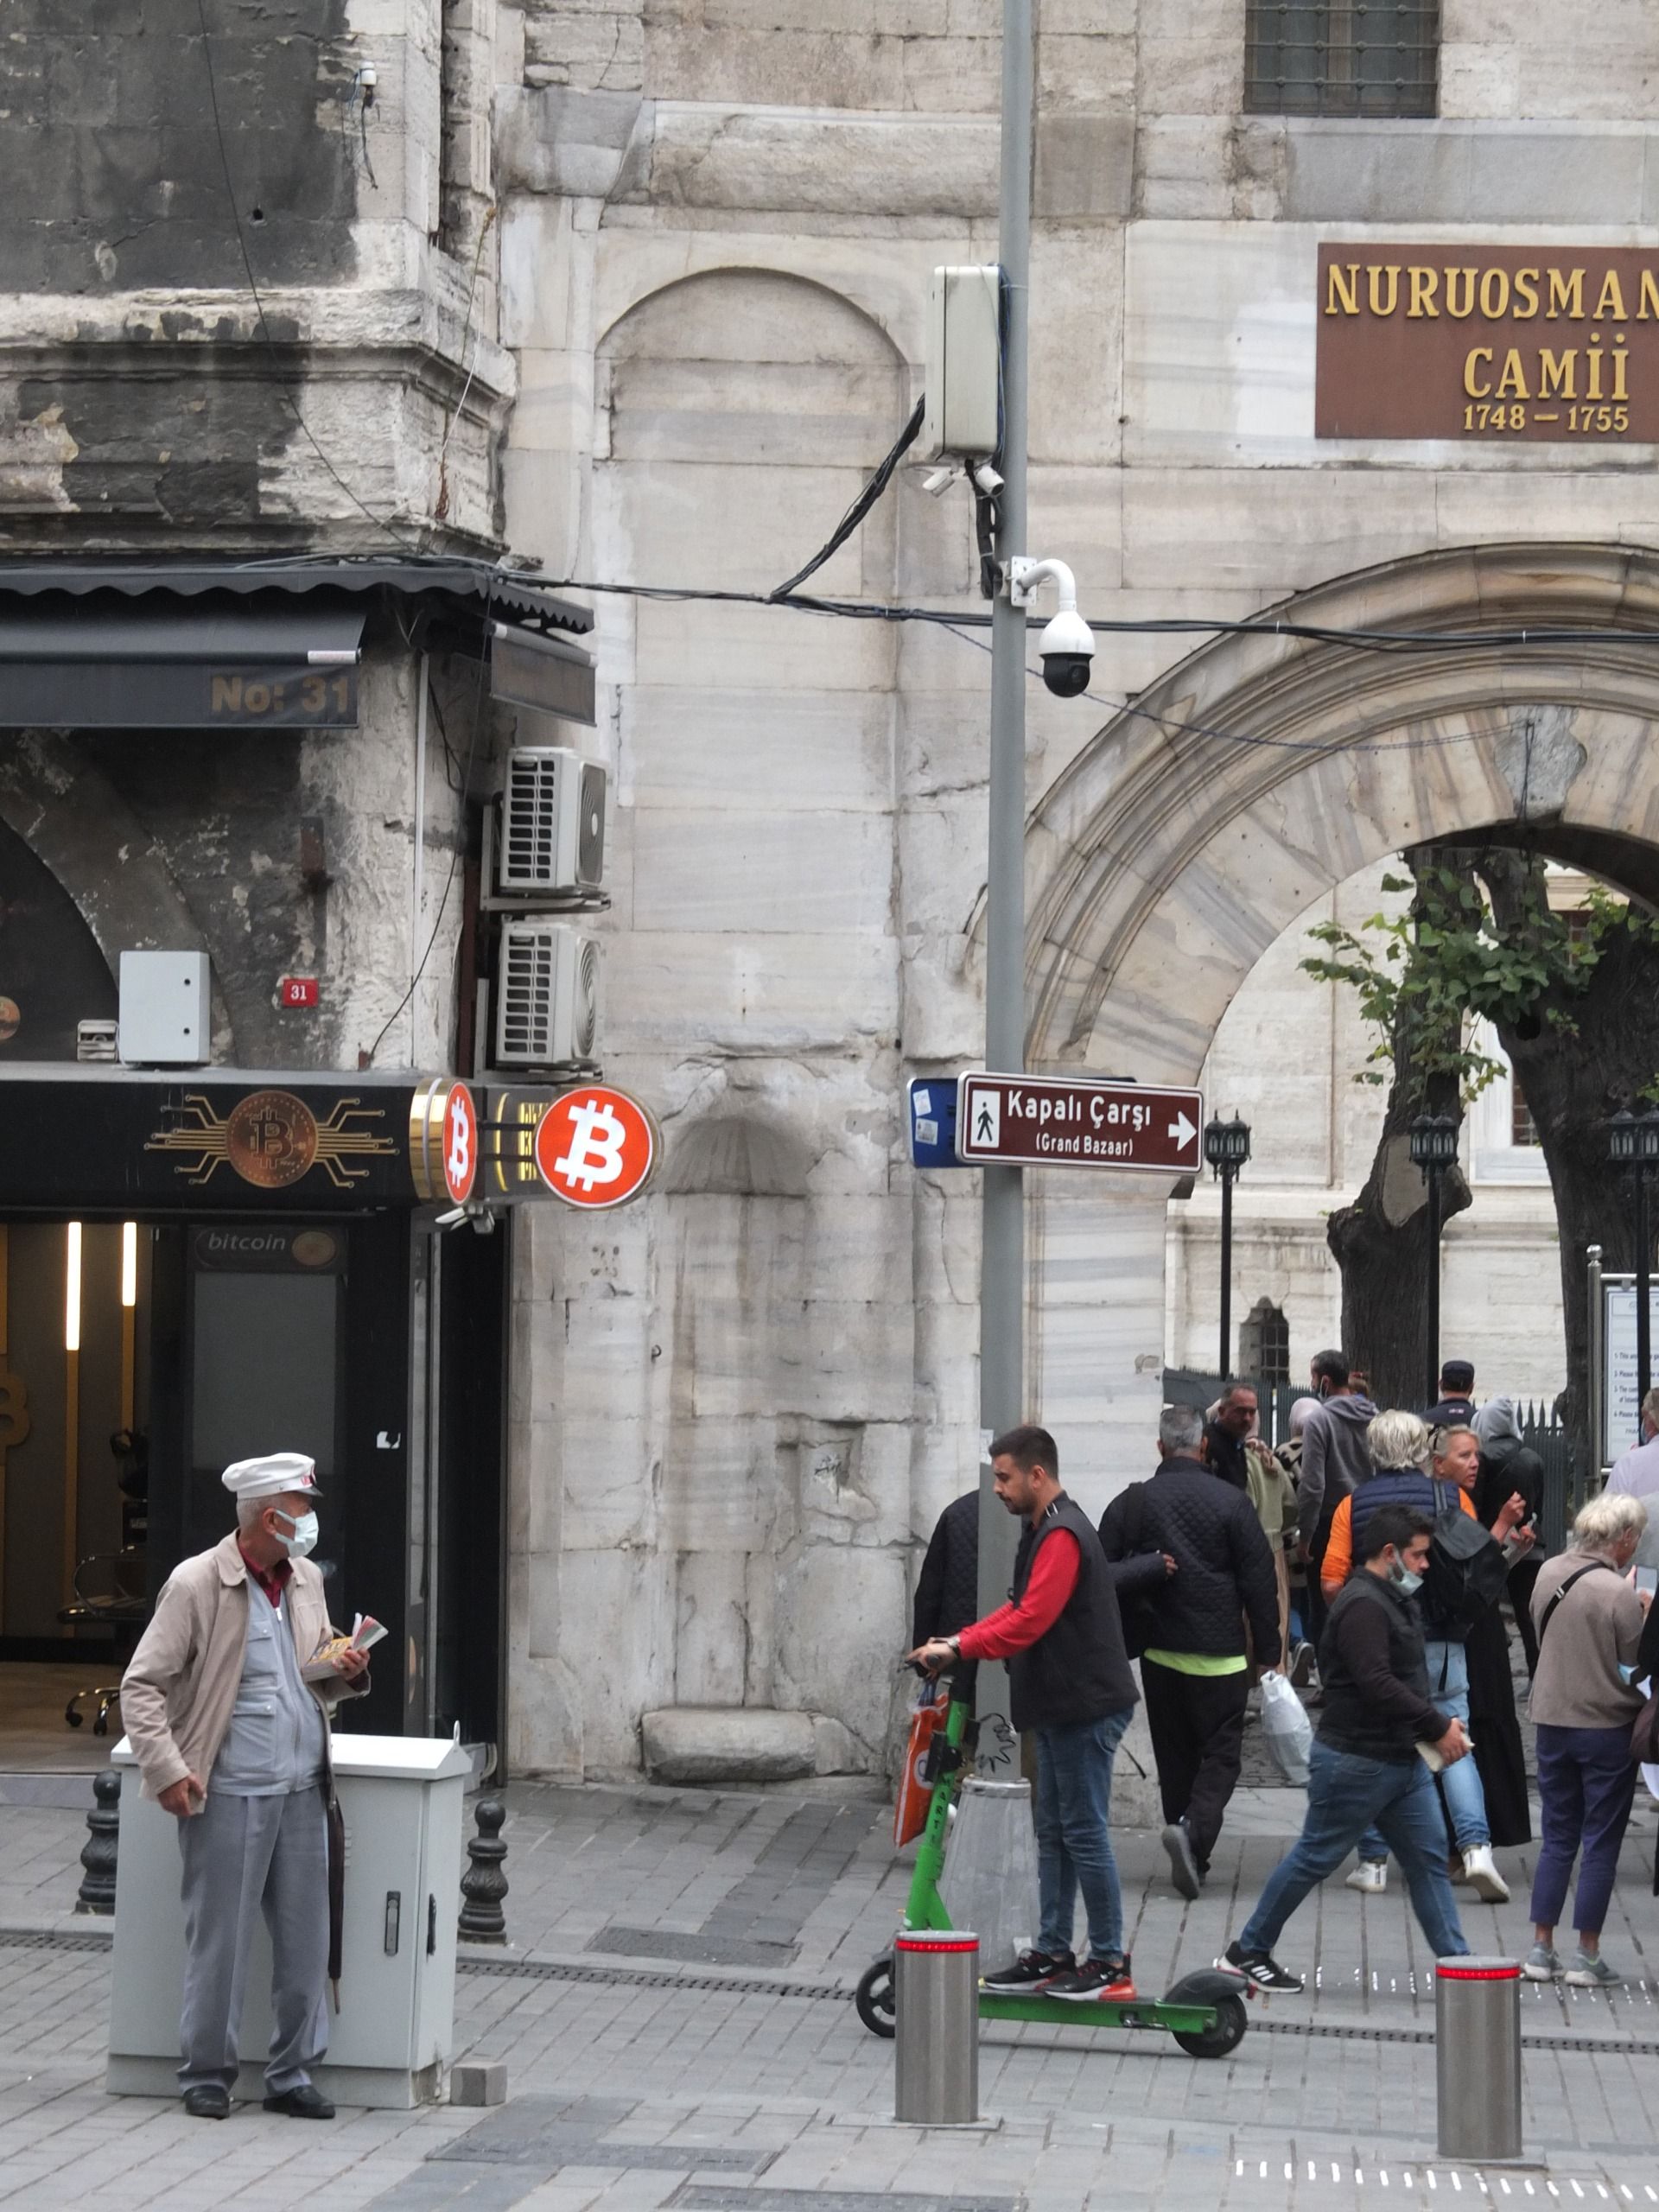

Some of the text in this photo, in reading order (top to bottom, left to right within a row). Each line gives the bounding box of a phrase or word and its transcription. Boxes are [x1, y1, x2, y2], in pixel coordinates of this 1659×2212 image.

[1324, 264, 1659, 321] NURUOSMAN
[1463, 332, 1630, 401] CAMİİ
[1463, 404, 1526, 432] 1748
[1567, 406, 1630, 433] 1755
[212, 676, 349, 714] No: 31
[290, 984, 307, 1001] 31
[1007, 1090, 1152, 1132] Kapalı Çarşı
[1036, 1133, 1134, 1156] (Grand Bazaar)
[208, 1233, 286, 1251] bitcoin
